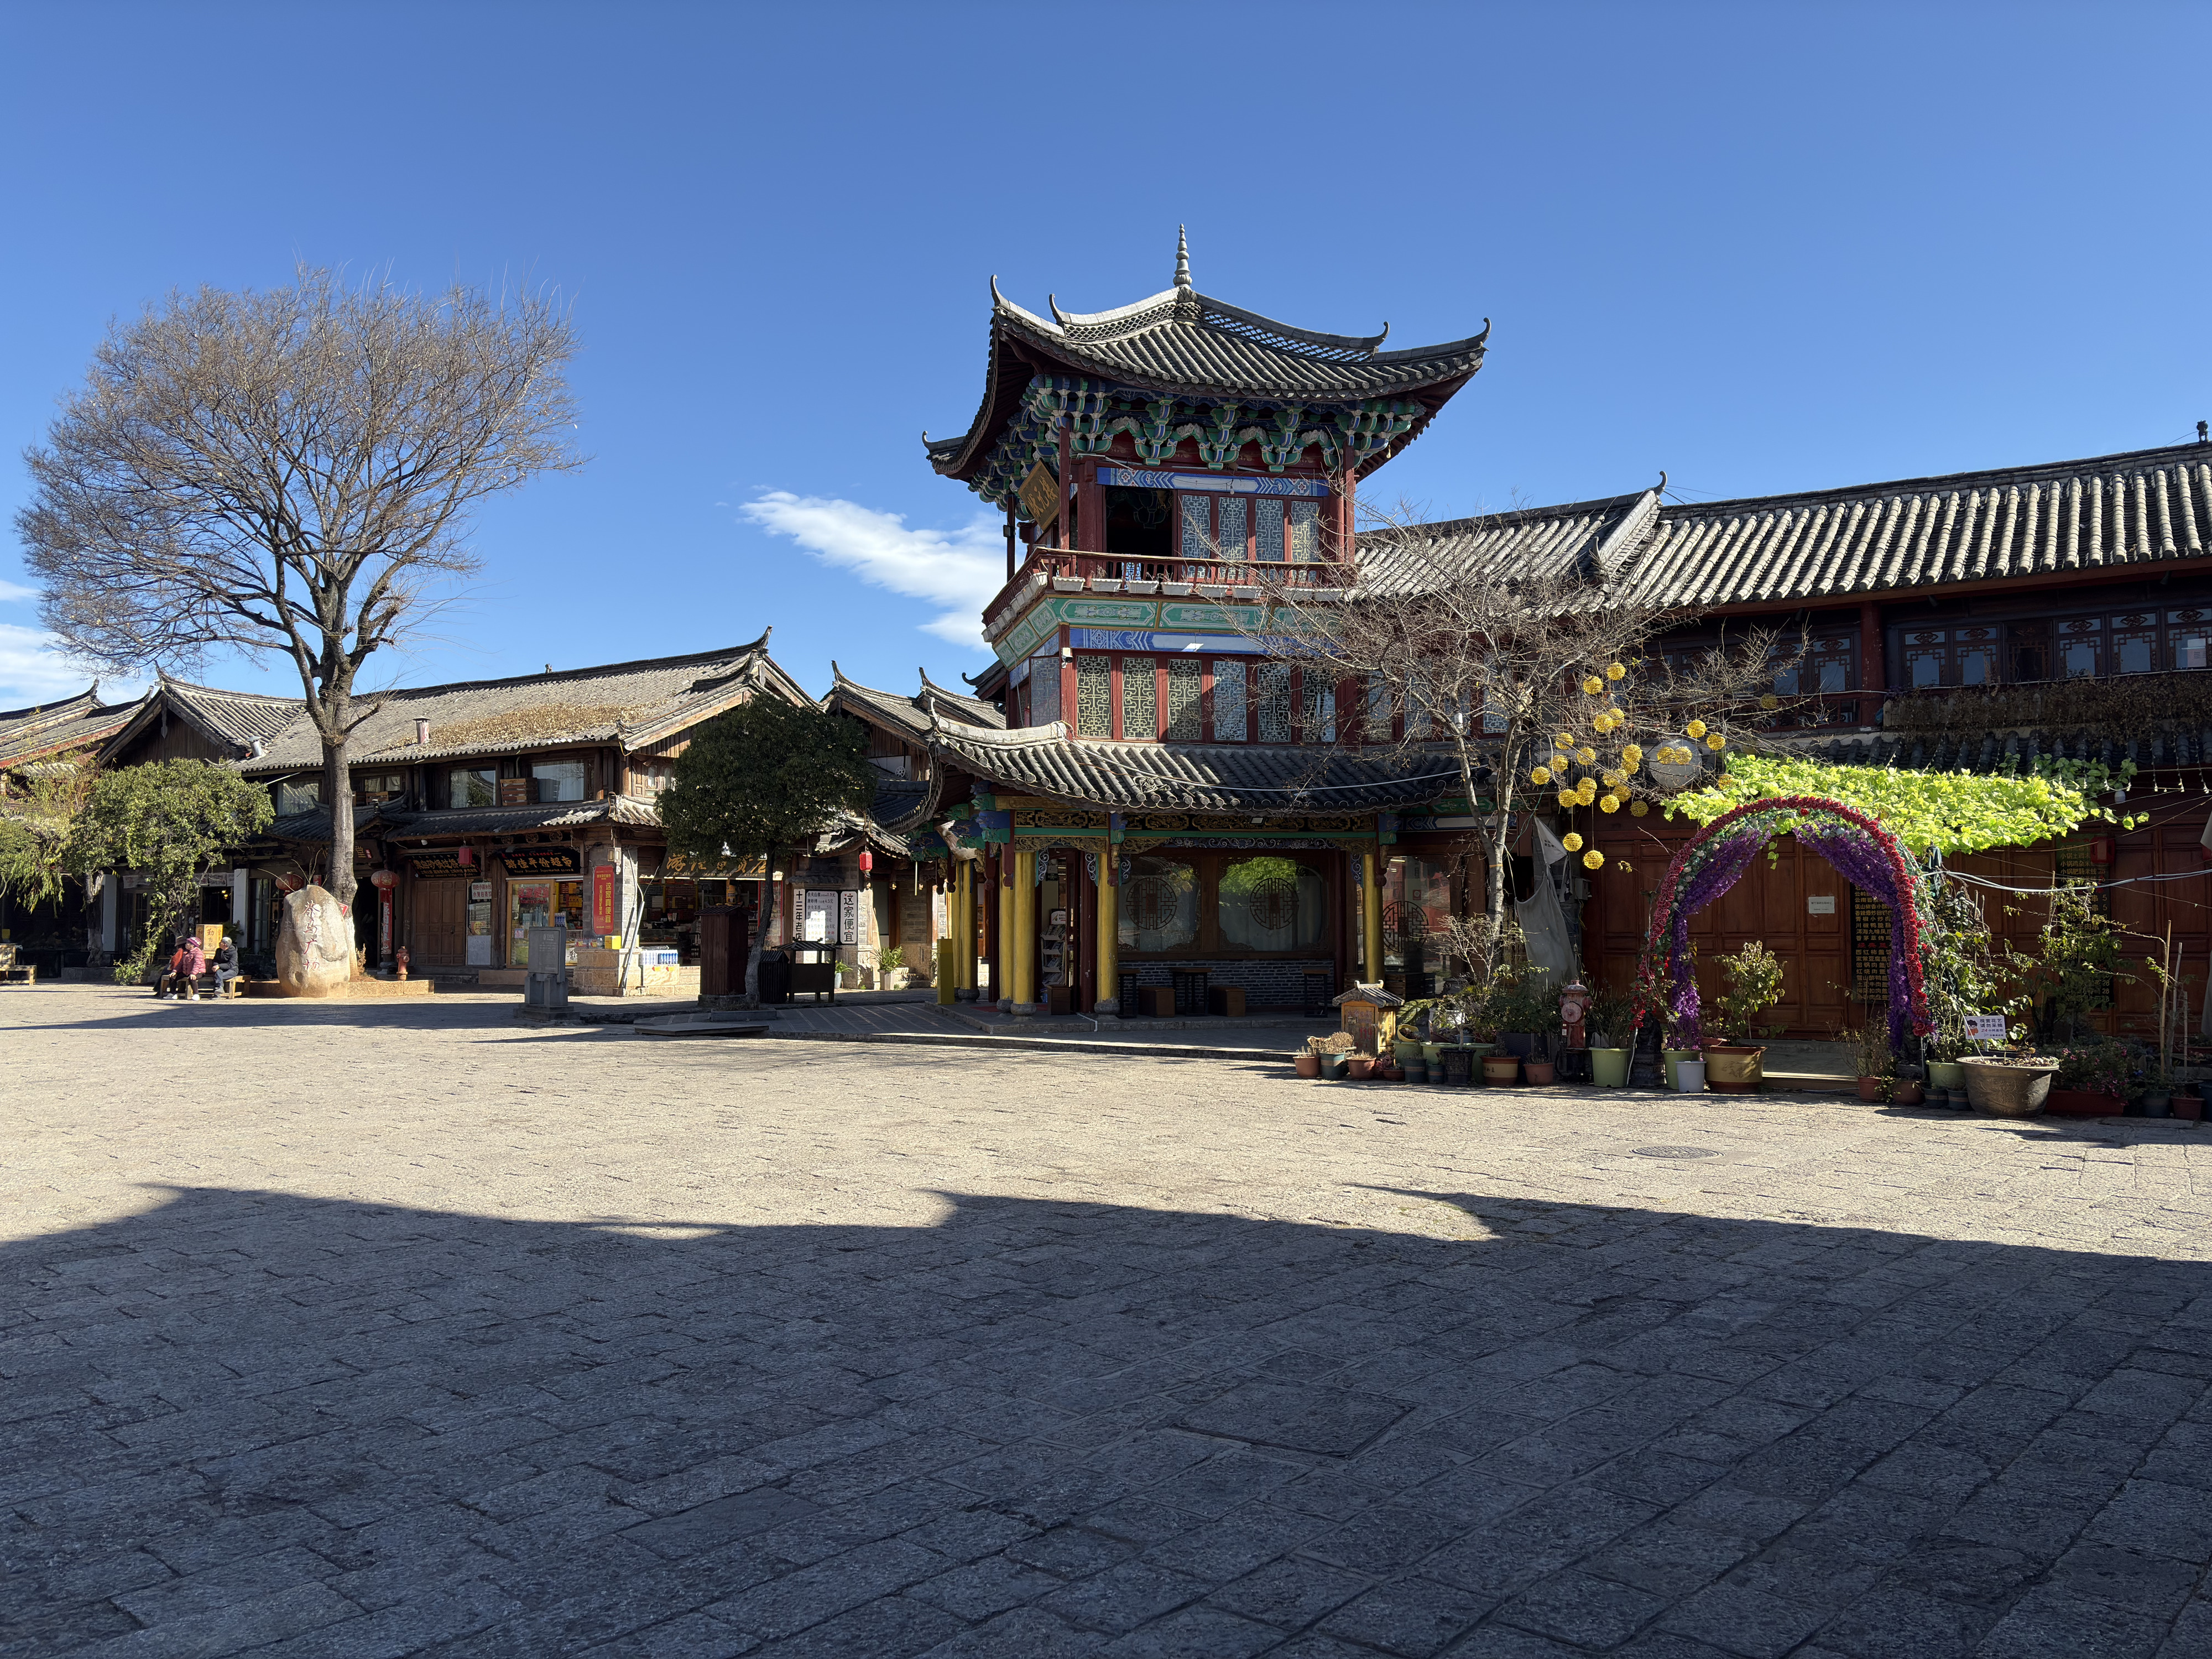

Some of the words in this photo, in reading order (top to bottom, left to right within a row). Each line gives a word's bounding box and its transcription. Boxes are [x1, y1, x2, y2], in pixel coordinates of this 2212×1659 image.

[301, 900, 320, 972] 茶马广场
[844, 894, 854, 942] 这家便宜
